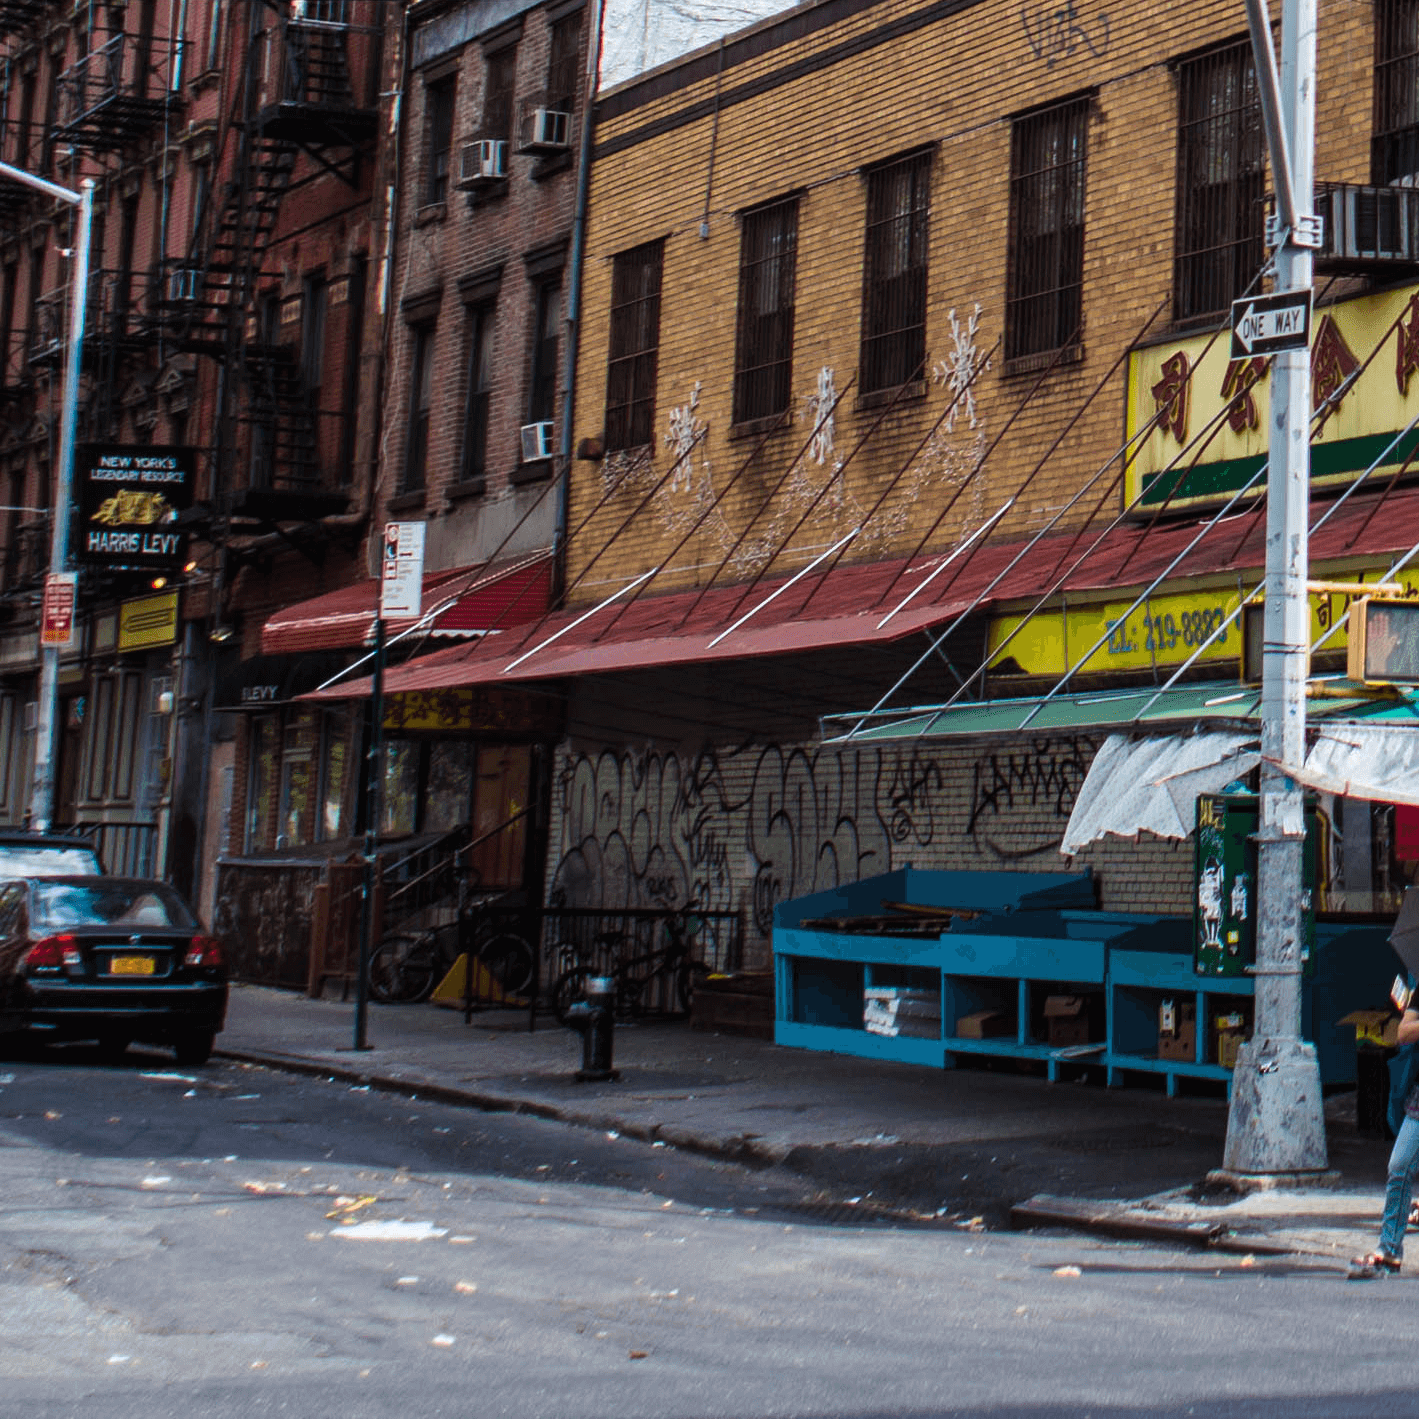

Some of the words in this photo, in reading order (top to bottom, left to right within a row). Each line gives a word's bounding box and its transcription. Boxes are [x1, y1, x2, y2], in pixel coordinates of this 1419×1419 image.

[1242, 317, 1264, 341] ONE
[1274, 307, 1301, 334] WAY
[100, 455, 132, 468] NEW
[135, 456, 177, 470] YORK'S
[140, 470, 185, 483] RESOURCE
[88, 531, 141, 553] HARRIS
[142, 532, 180, 555] LEVY
